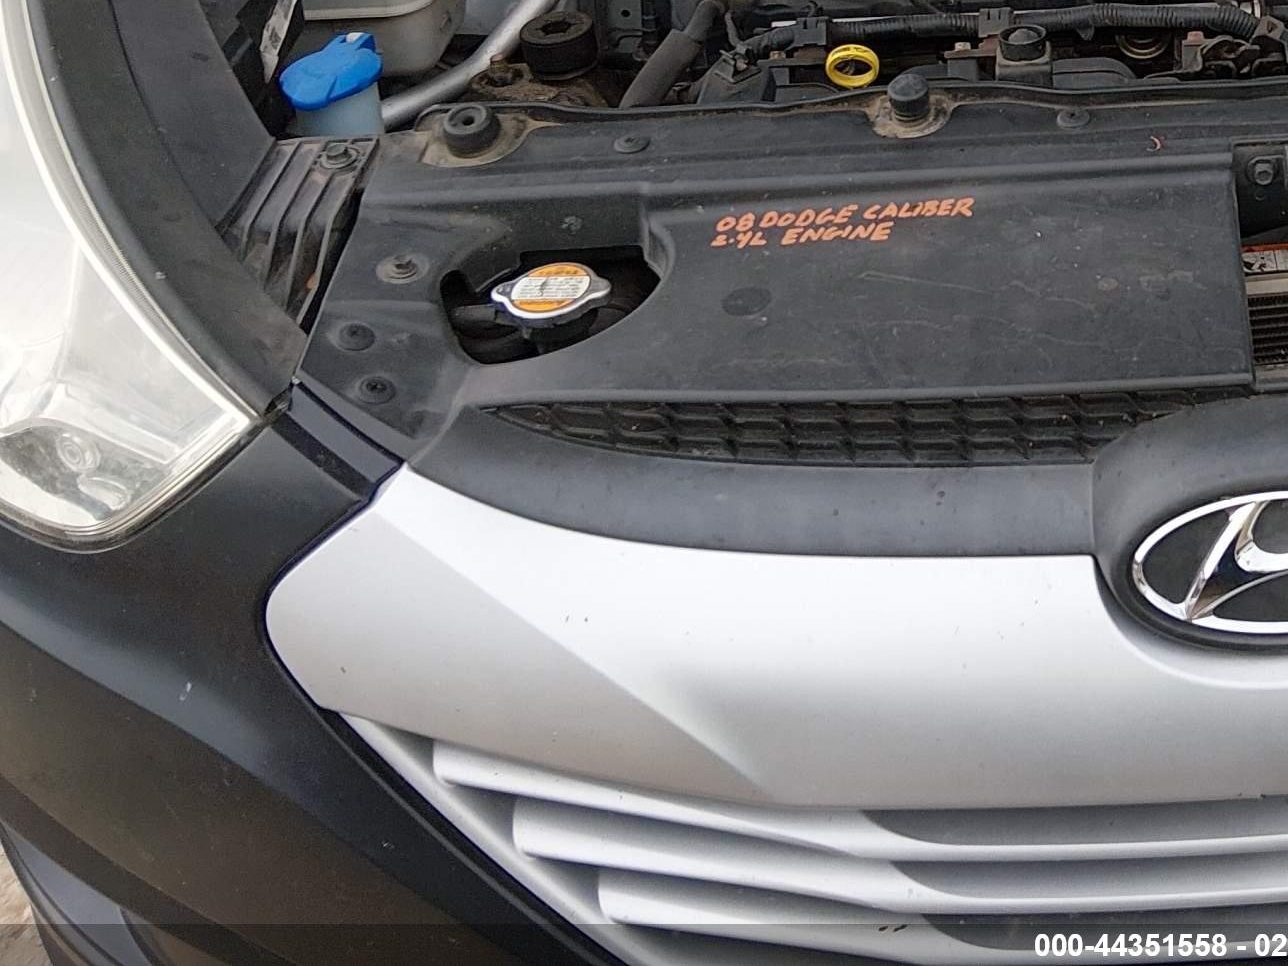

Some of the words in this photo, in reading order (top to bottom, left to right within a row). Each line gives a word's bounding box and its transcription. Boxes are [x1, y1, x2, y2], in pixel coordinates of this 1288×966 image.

[715, 214, 757, 233] 08
[759, 204, 859, 229] DODGE
[864, 197, 975, 219] CALIBER
[781, 221, 895, 245] ENGINE
